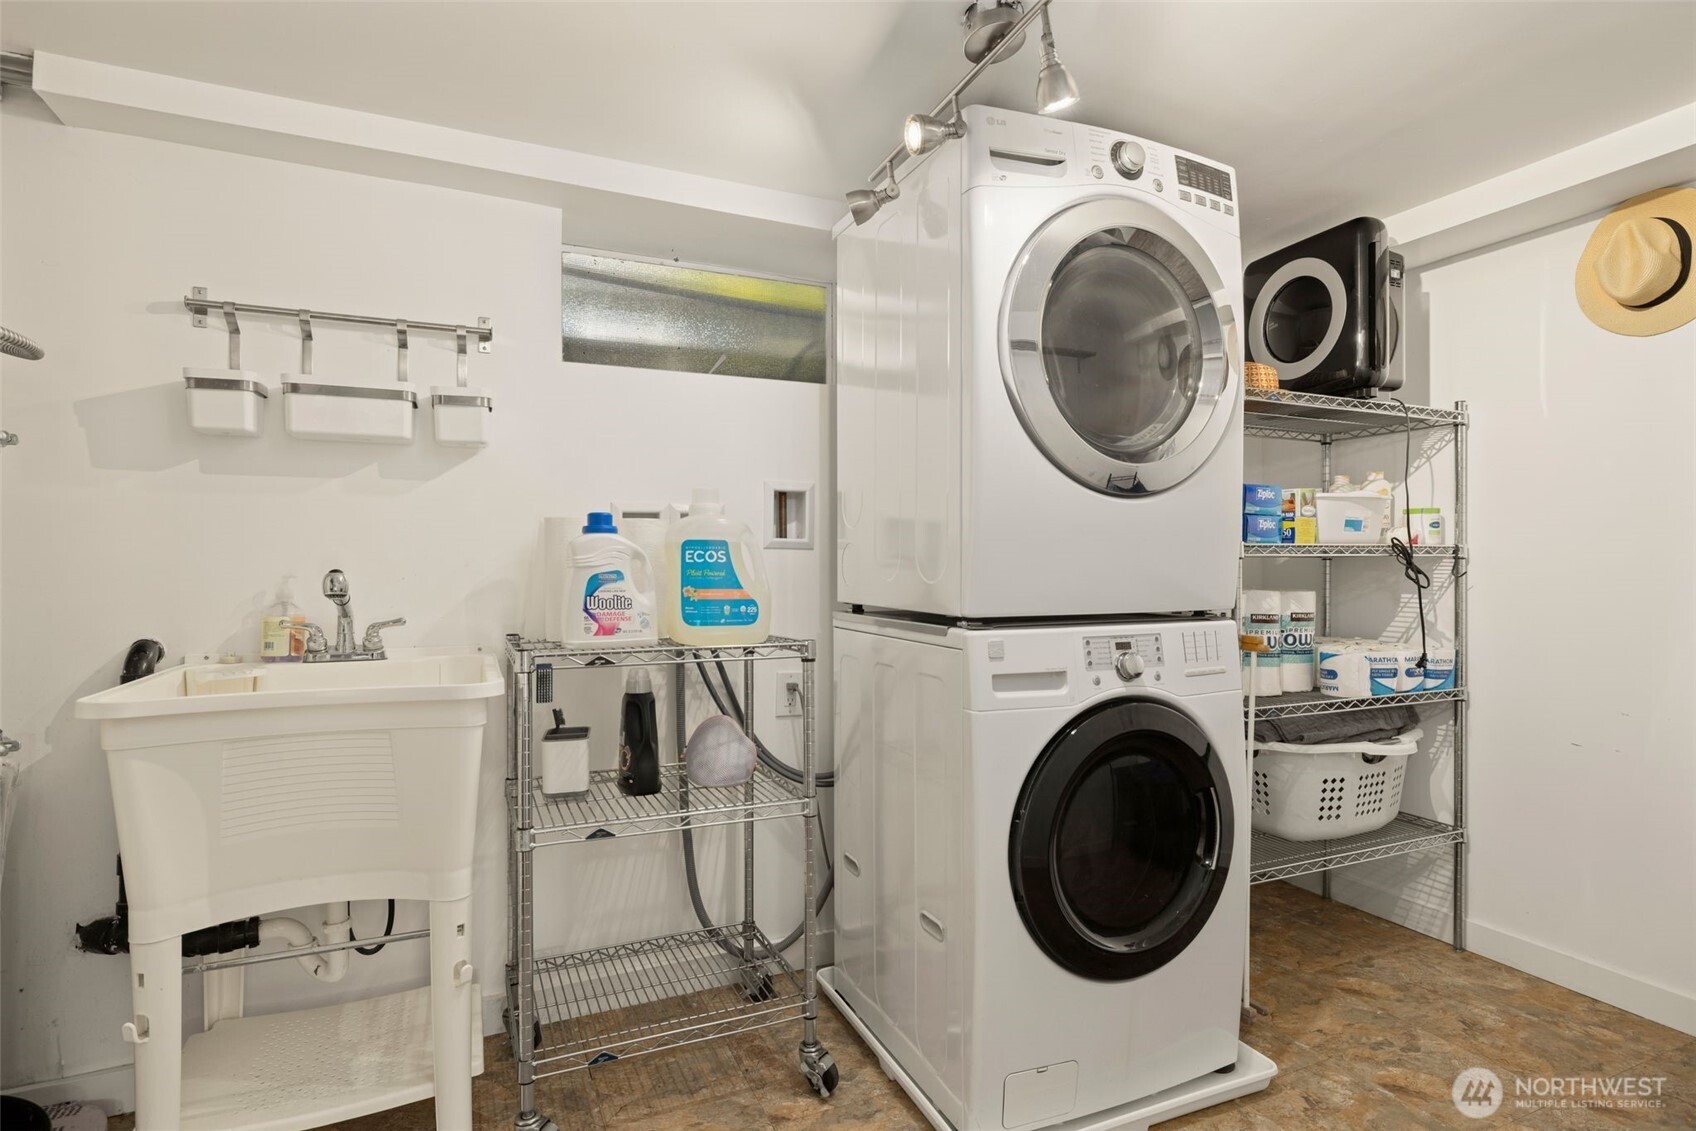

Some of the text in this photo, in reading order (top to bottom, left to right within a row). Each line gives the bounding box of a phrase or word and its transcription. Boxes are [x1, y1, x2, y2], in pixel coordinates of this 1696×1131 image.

[1257, 489, 1275, 500] Ziploc
[1259, 519, 1275, 530] Ziploc
[685, 550, 727, 563] ECOS
[586, 594, 633, 611] Woolite
